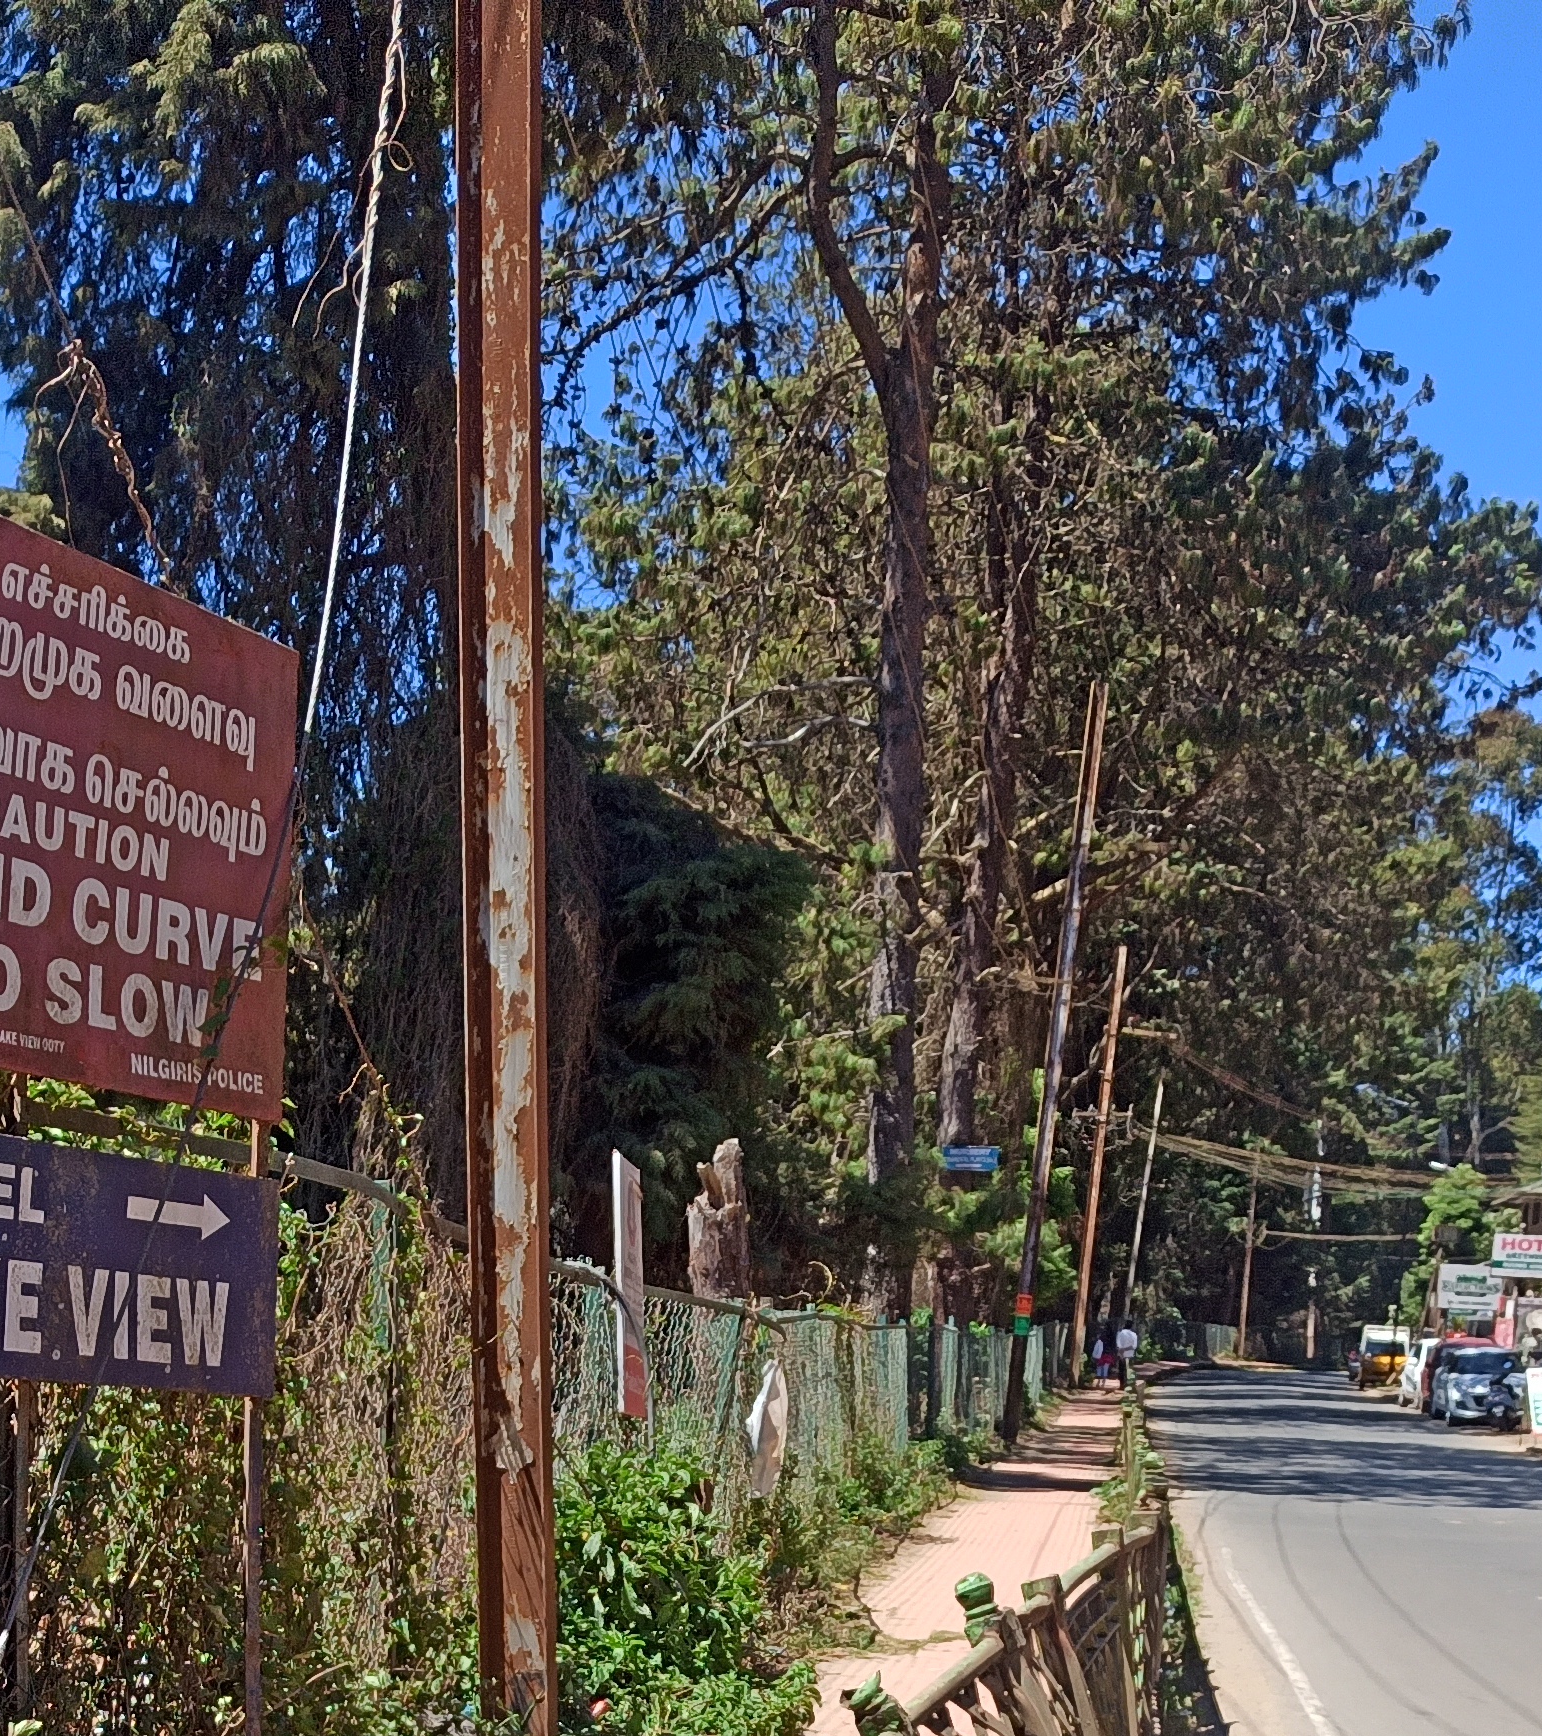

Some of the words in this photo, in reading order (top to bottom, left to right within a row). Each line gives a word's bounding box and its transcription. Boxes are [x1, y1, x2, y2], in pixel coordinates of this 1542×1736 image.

[0, 561, 193, 665] எச்சரிக்கை
[115, 663, 257, 772] வளைவு
[84, 752, 268, 864] செல்லவும்
[72, 876, 264, 983] CURVE
[19, 1032, 42, 1050] VIEW
[42, 1036, 66, 1054] OOTY
[44, 957, 210, 1049] SLOW
[130, 1052, 204, 1085] NILGIRIS
[207, 1066, 264, 1095] POLICE
[67, 1263, 230, 1368] VIEW
